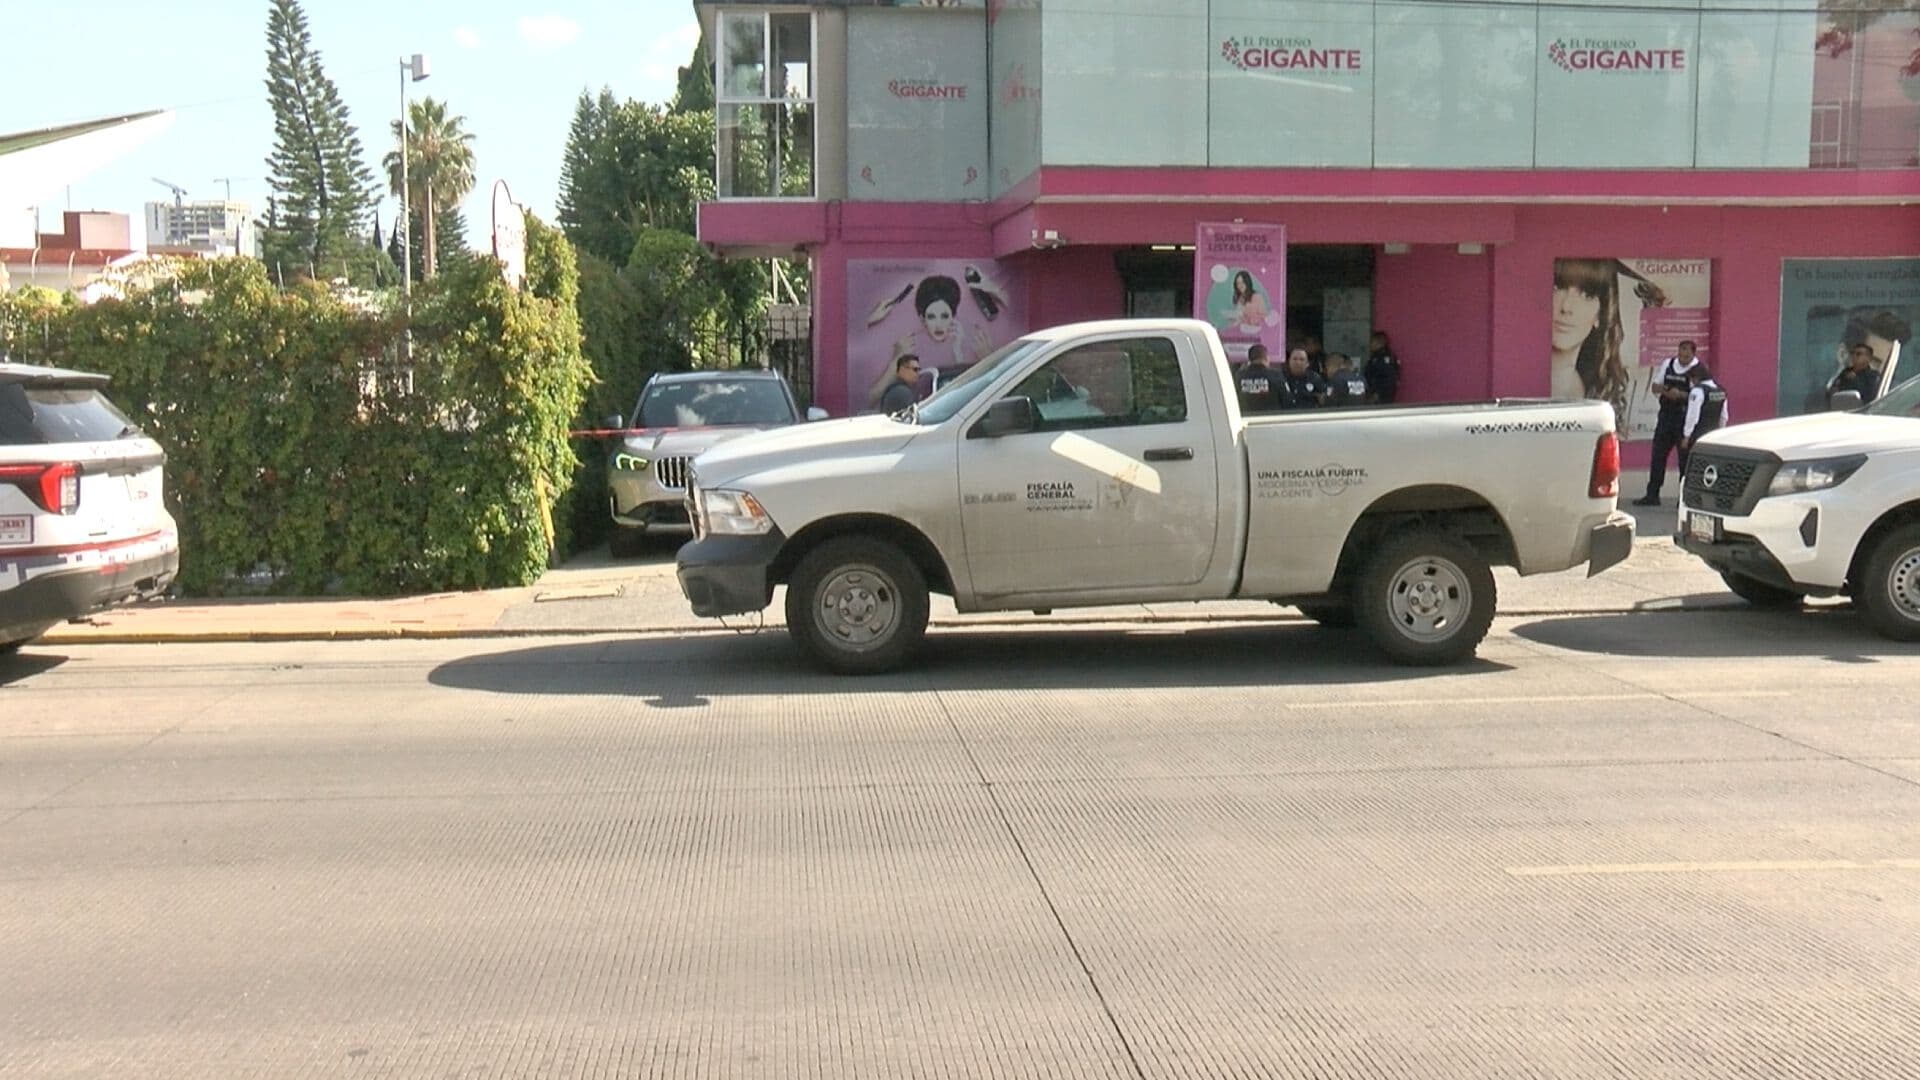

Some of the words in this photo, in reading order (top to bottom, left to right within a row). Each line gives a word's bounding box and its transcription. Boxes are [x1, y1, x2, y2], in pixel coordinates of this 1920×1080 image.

[1243, 48, 1361, 69] GIGANTE
[1570, 50, 1685, 69] GIGANTE
[900, 85, 967, 98] GIGANTE
[1214, 233, 1267, 243] SURTIMOS
[1208, 242, 1242, 252] LISTAS
[1245, 243, 1273, 253] PARA
[1646, 263, 1704, 274] GIGANTE
[1257, 471, 1279, 479] UNA
[1027, 481, 1074, 491] FISCALÍA
[1027, 491, 1075, 499] GENERAL
